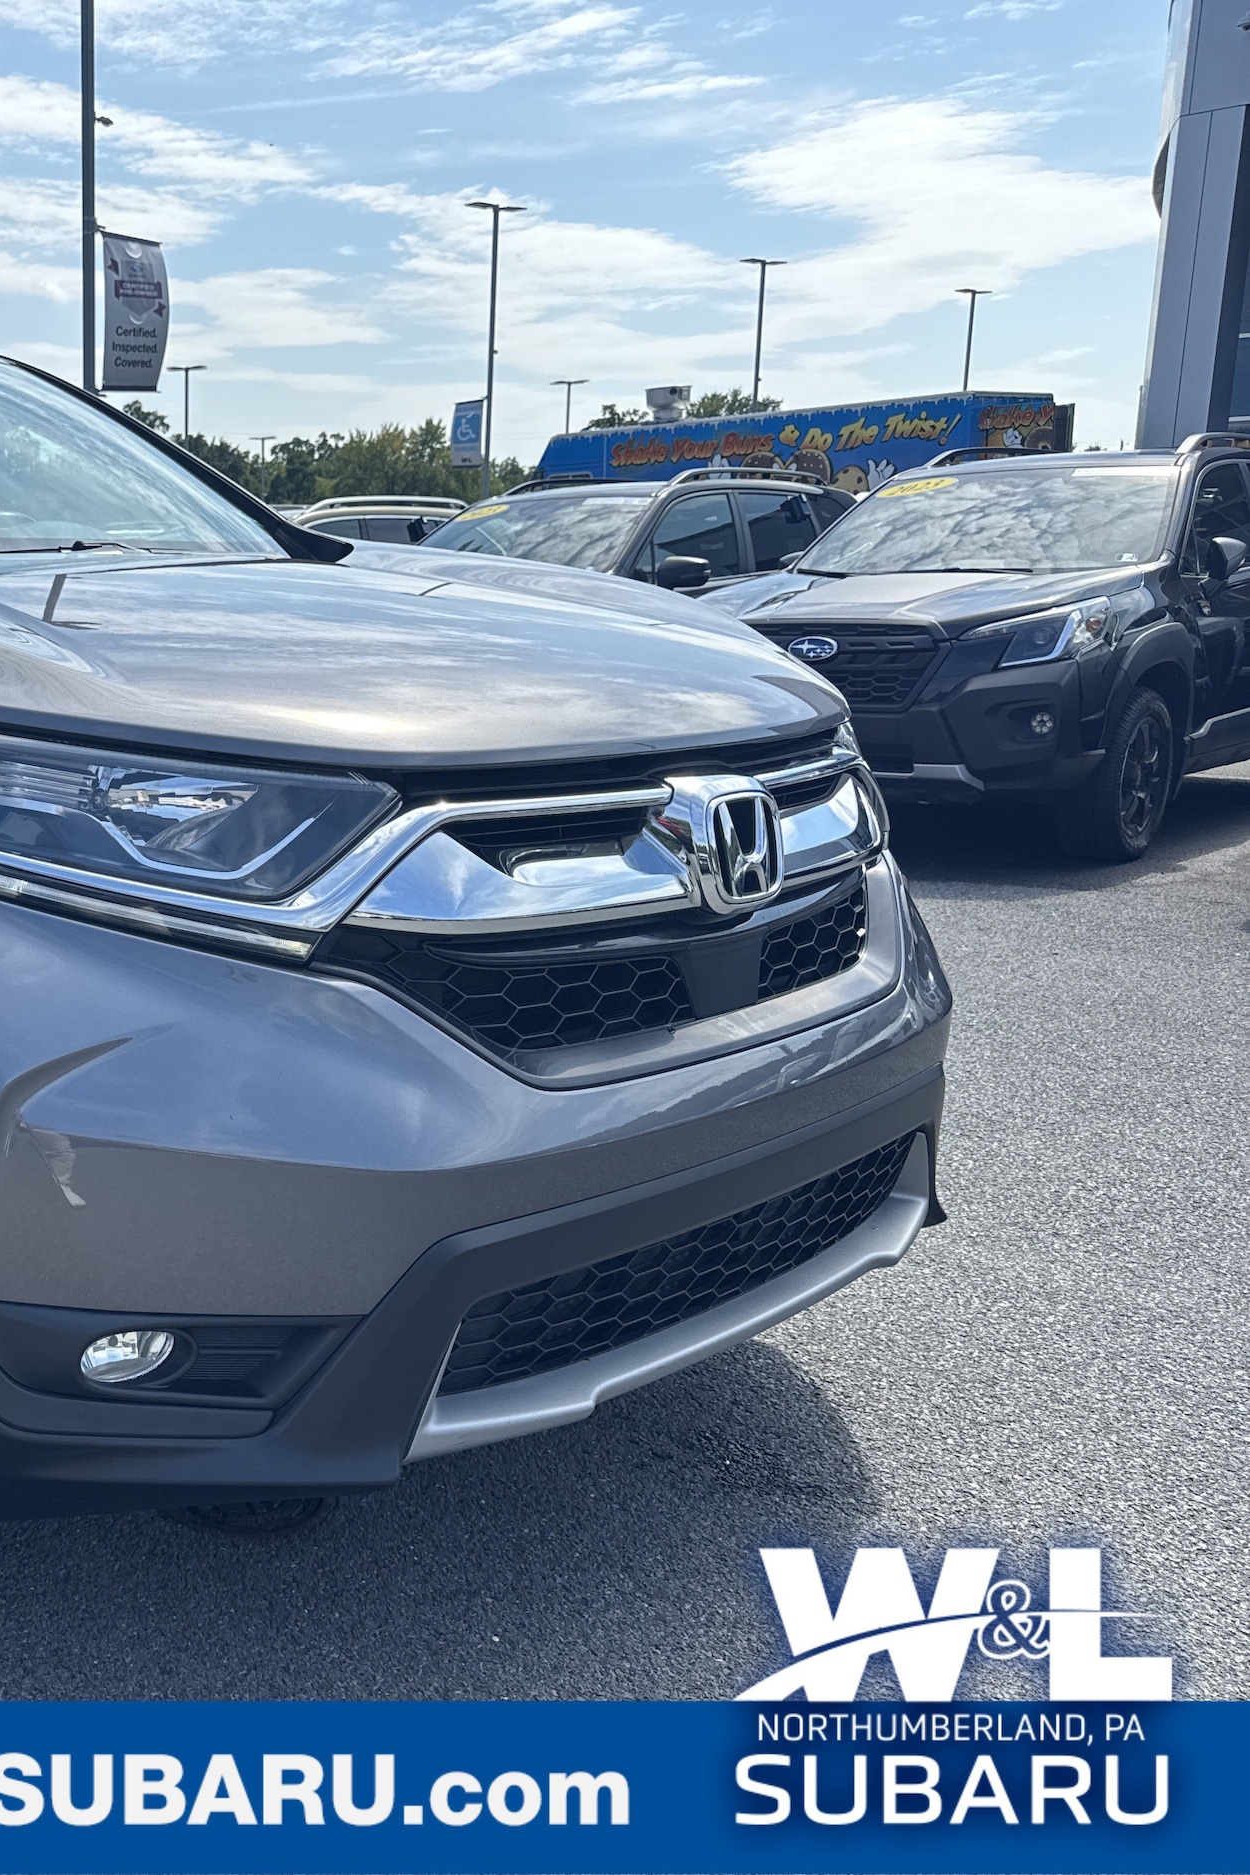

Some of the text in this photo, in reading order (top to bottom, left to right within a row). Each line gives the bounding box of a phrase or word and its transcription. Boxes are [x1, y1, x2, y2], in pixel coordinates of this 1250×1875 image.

[116, 326, 158, 338] Certified.
[112, 342, 159, 355] Inspected.
[114, 357, 154, 368] Covered.
[978, 404, 1036, 431] Shake
[609, 411, 962, 467] Shake Your Buns & Do The Twist!
